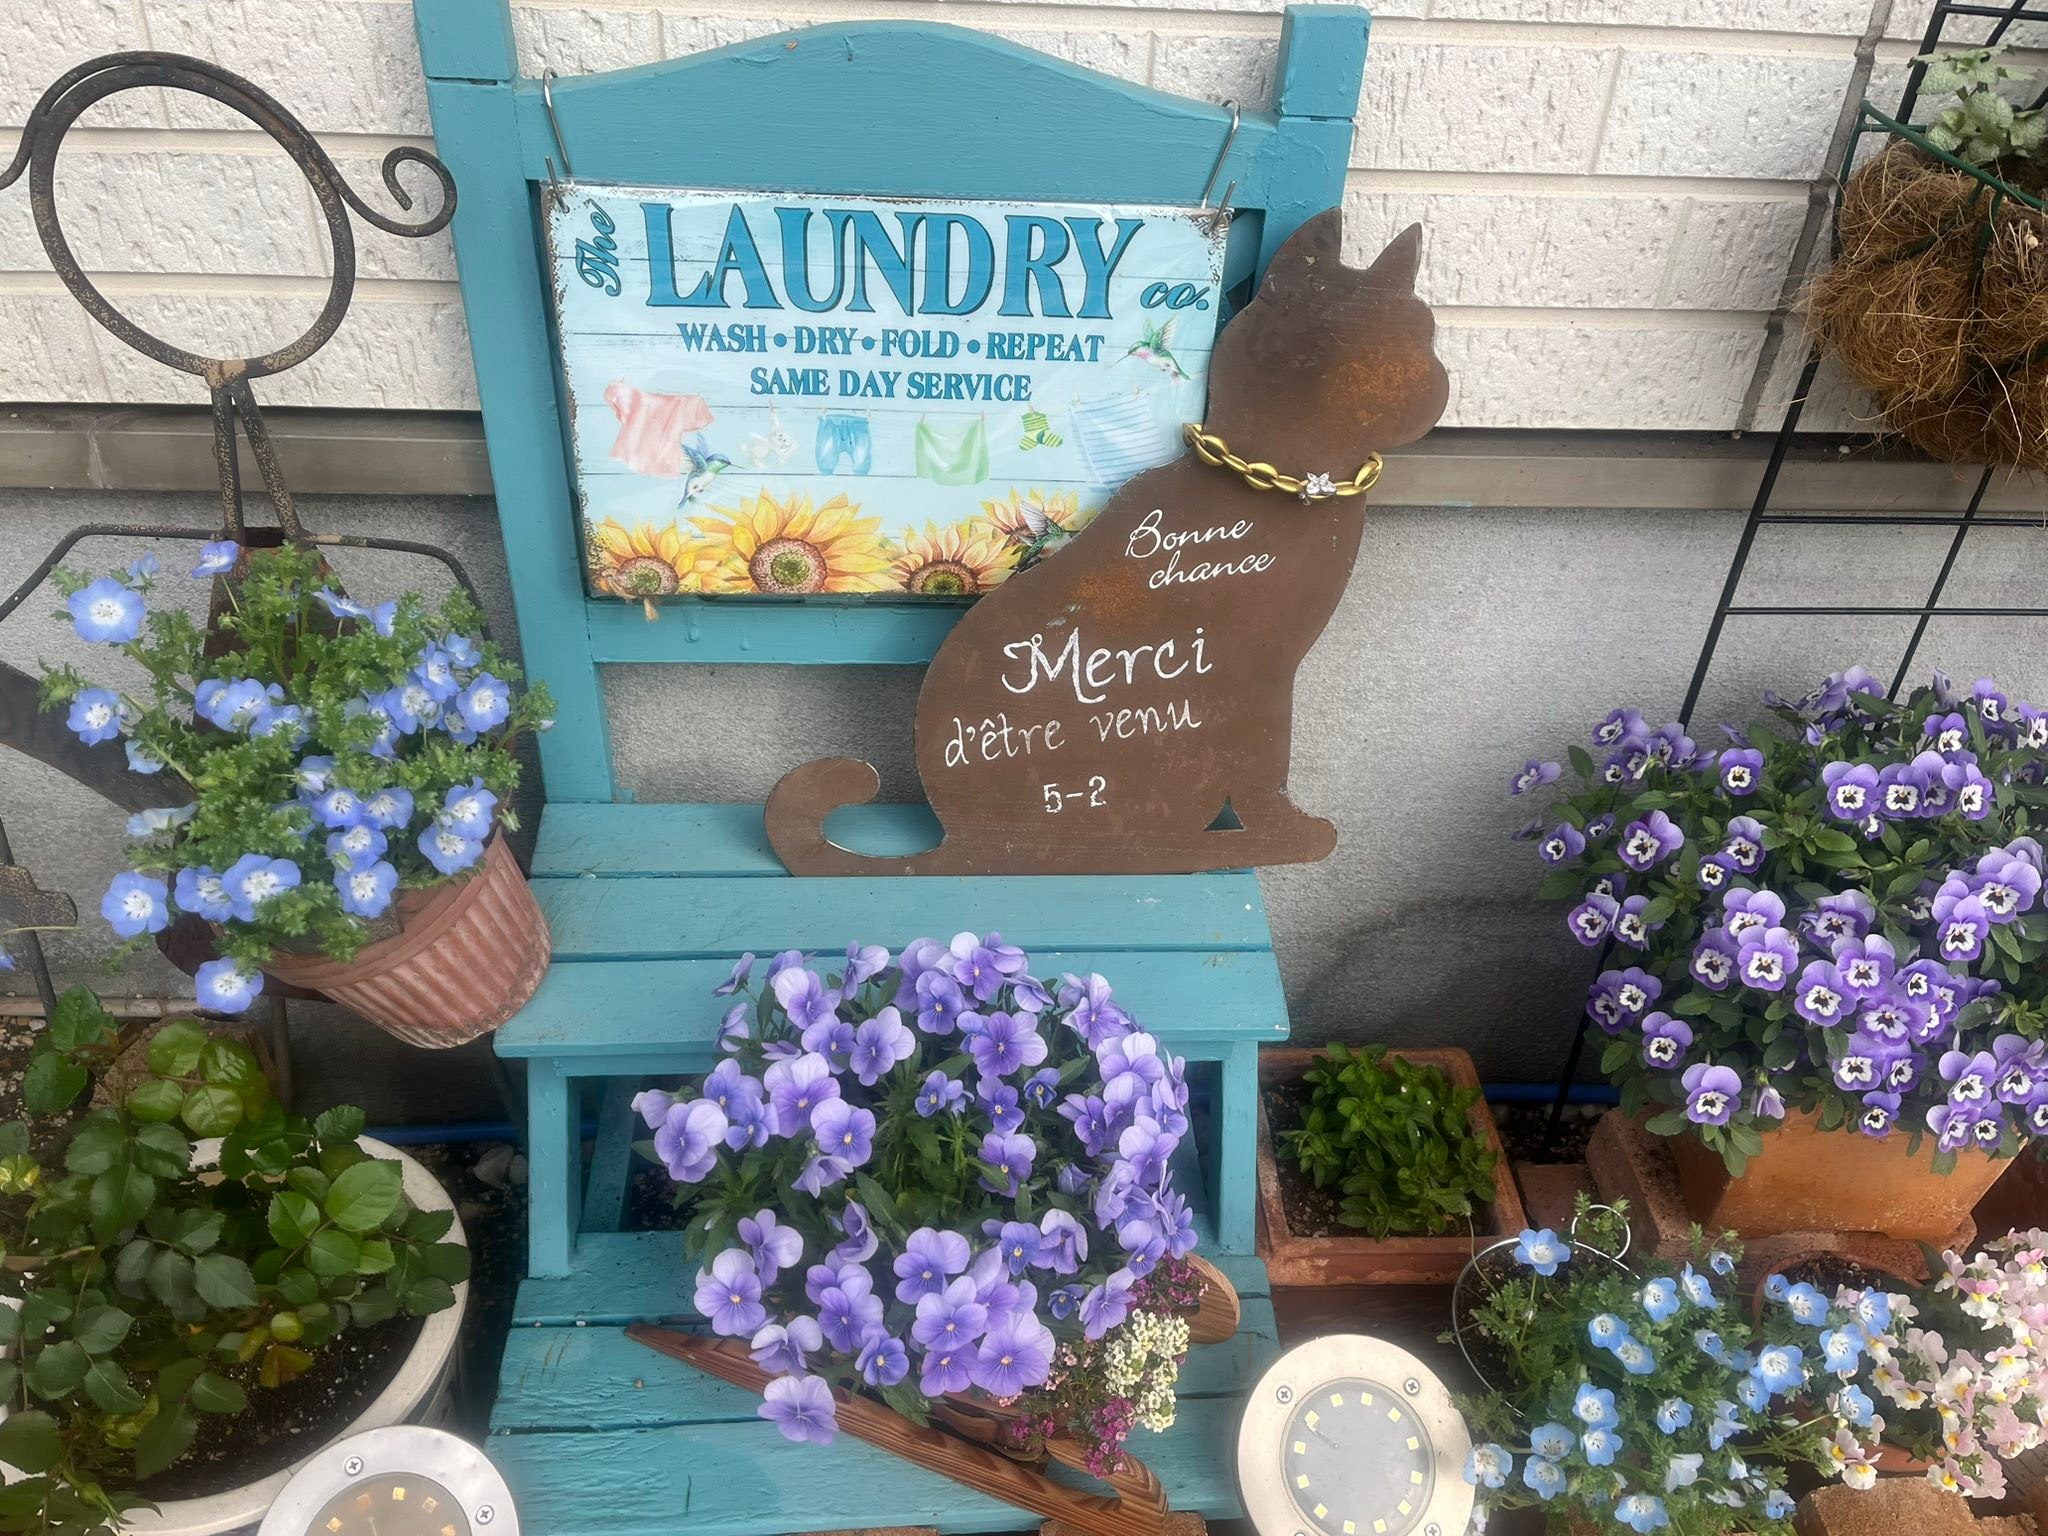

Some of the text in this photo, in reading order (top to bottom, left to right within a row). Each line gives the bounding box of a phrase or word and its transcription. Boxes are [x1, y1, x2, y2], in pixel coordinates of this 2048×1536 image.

[575, 198, 622, 297] The
[639, 202, 1145, 320] LAUNDRY
[677, 322, 1105, 363] WASH DRY FOLD REPEAT
[750, 366, 1032, 402] SAME DAY SERVICE
[1125, 508, 1254, 559] Bonne
[1148, 550, 1277, 590] chance
[1001, 626, 1214, 705] Merci
[1089, 698, 1203, 742] venu
[1042, 775, 1108, 814] 5-2
